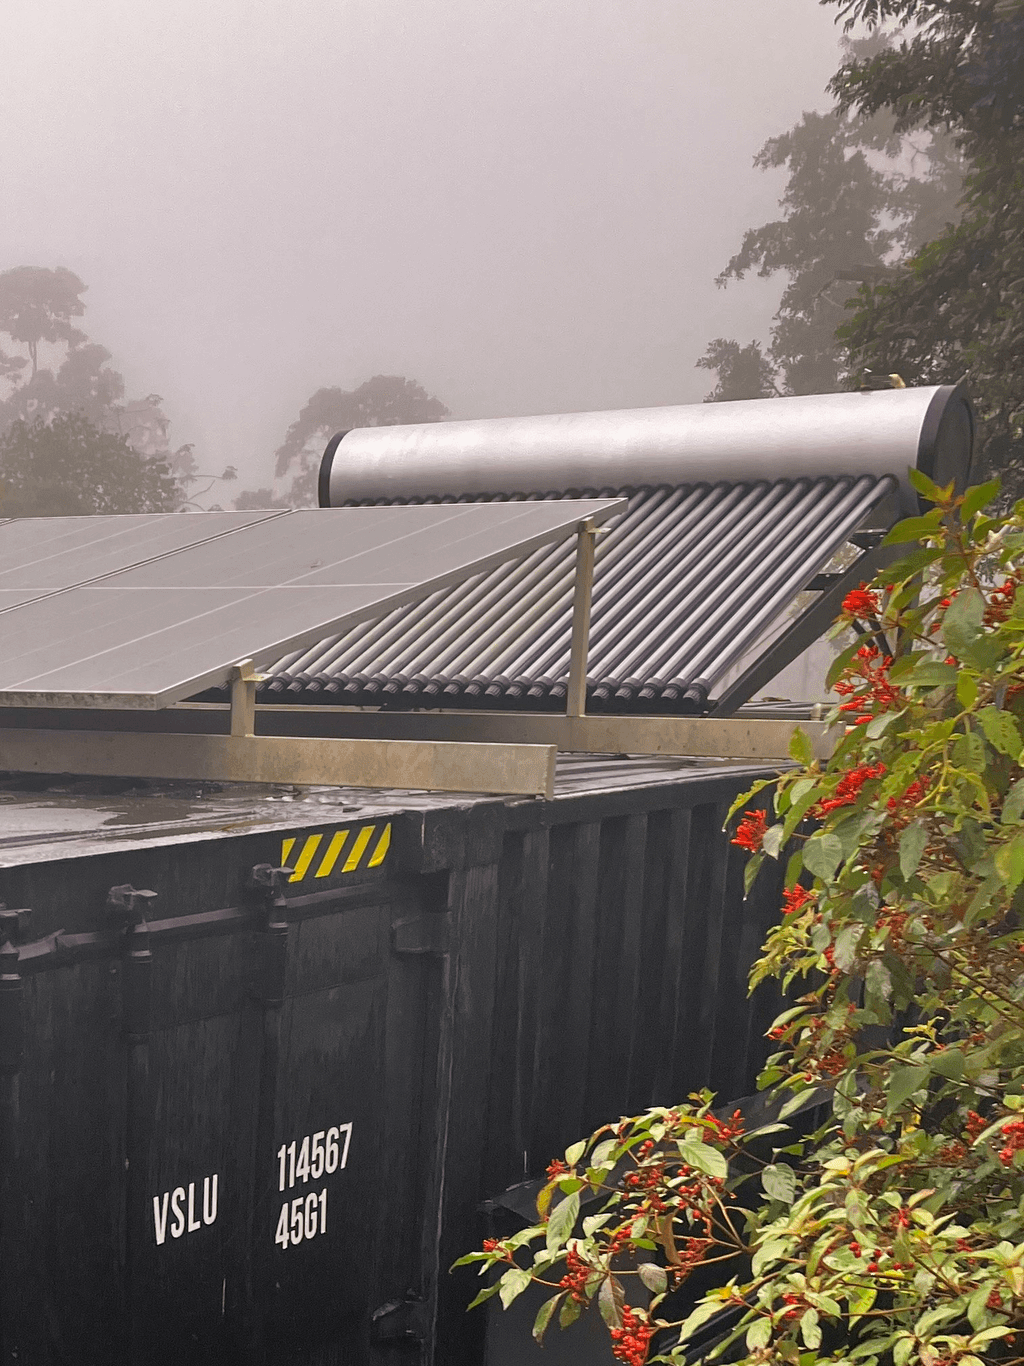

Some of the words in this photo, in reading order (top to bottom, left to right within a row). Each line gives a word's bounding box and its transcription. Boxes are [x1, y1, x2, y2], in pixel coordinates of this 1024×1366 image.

[152, 1173, 219, 1246] VSLU
[277, 1121, 353, 1192] 114567
[274, 1187, 327, 1250] 45G1
